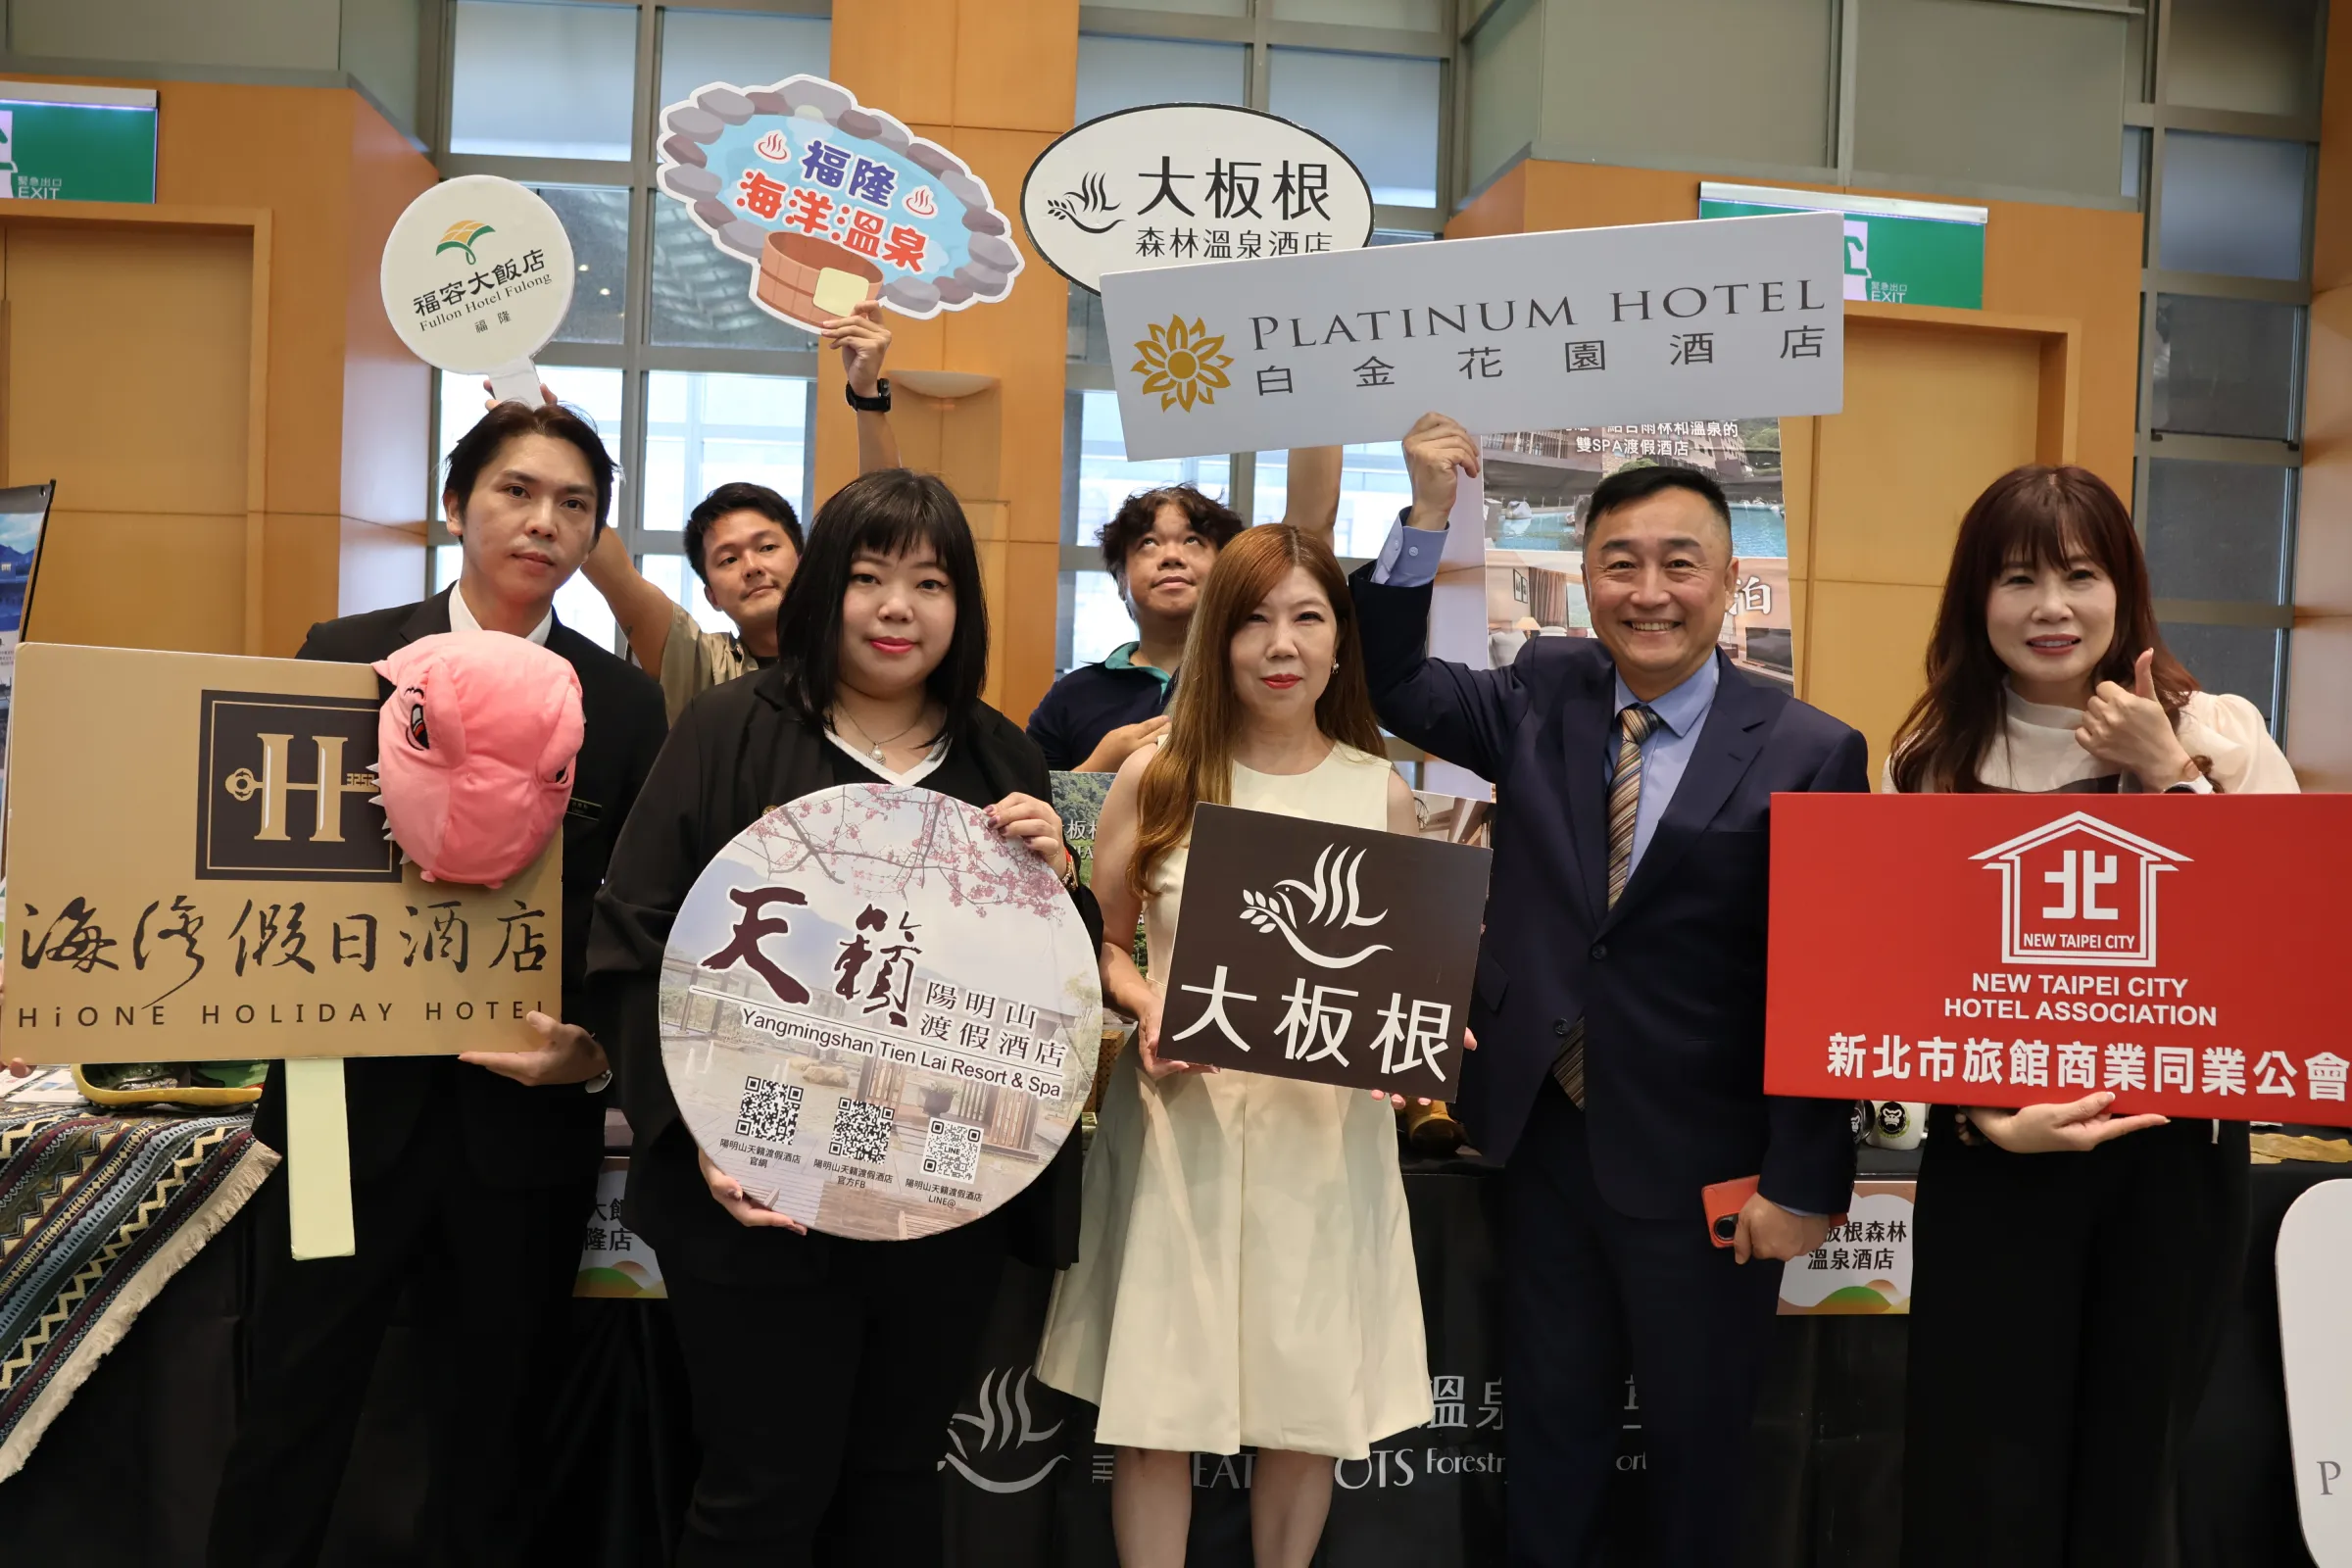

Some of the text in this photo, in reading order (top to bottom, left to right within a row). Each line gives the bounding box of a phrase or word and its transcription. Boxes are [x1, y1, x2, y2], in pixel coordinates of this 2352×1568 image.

[18, 176, 62, 187] 緊急出口
[802, 140, 896, 207] 福隆
[18, 186, 60, 200] EXIT
[1137, 156, 1331, 221] 大板根
[736, 171, 927, 272] 海洋溫泉
[1136, 226, 1333, 259] 森林溫泉酒店
[413, 249, 545, 317] 福容大飯店
[1871, 280, 1908, 292] 緊急出口
[419, 273, 552, 332] Fullon Hotel Fulong
[1871, 291, 1906, 304] EXIT
[474, 311, 511, 334] 福隆
[1249, 279, 1825, 351] PLATINUM HOTEL
[1256, 324, 1825, 396] 白金花園酒店
[1576, 436, 1689, 457] 雙SPA渡假酒店
[2024, 932, 2135, 950] NEW TAIPEI CITY
[1972, 972, 2188, 998] NEW TAIPEI CITY
[19, 1005, 165, 1028] HiONE
[202, 1003, 392, 1024] HOLIDAY
[925, 981, 1037, 1029] 陽明山
[1944, 998, 2217, 1026] HOTEL ASSOCIATION
[1171, 964, 1452, 1083] 大板根
[742, 1008, 1061, 1098] Yangmingshan Tien Lai Resort & Spa
[918, 1012, 1066, 1068] 渡假酒店
[1826, 1031, 2350, 1102] 新北市旅館商業同業公會
[750, 1156, 768, 1169] 官網
[944, 1146, 960, 1155] LINE
[837, 1175, 865, 1189] 官方FB
[928, 1195, 956, 1208] LINE@
[584, 1227, 633, 1251] 隆店
[1807, 1248, 1895, 1270] 溫泉酒店
